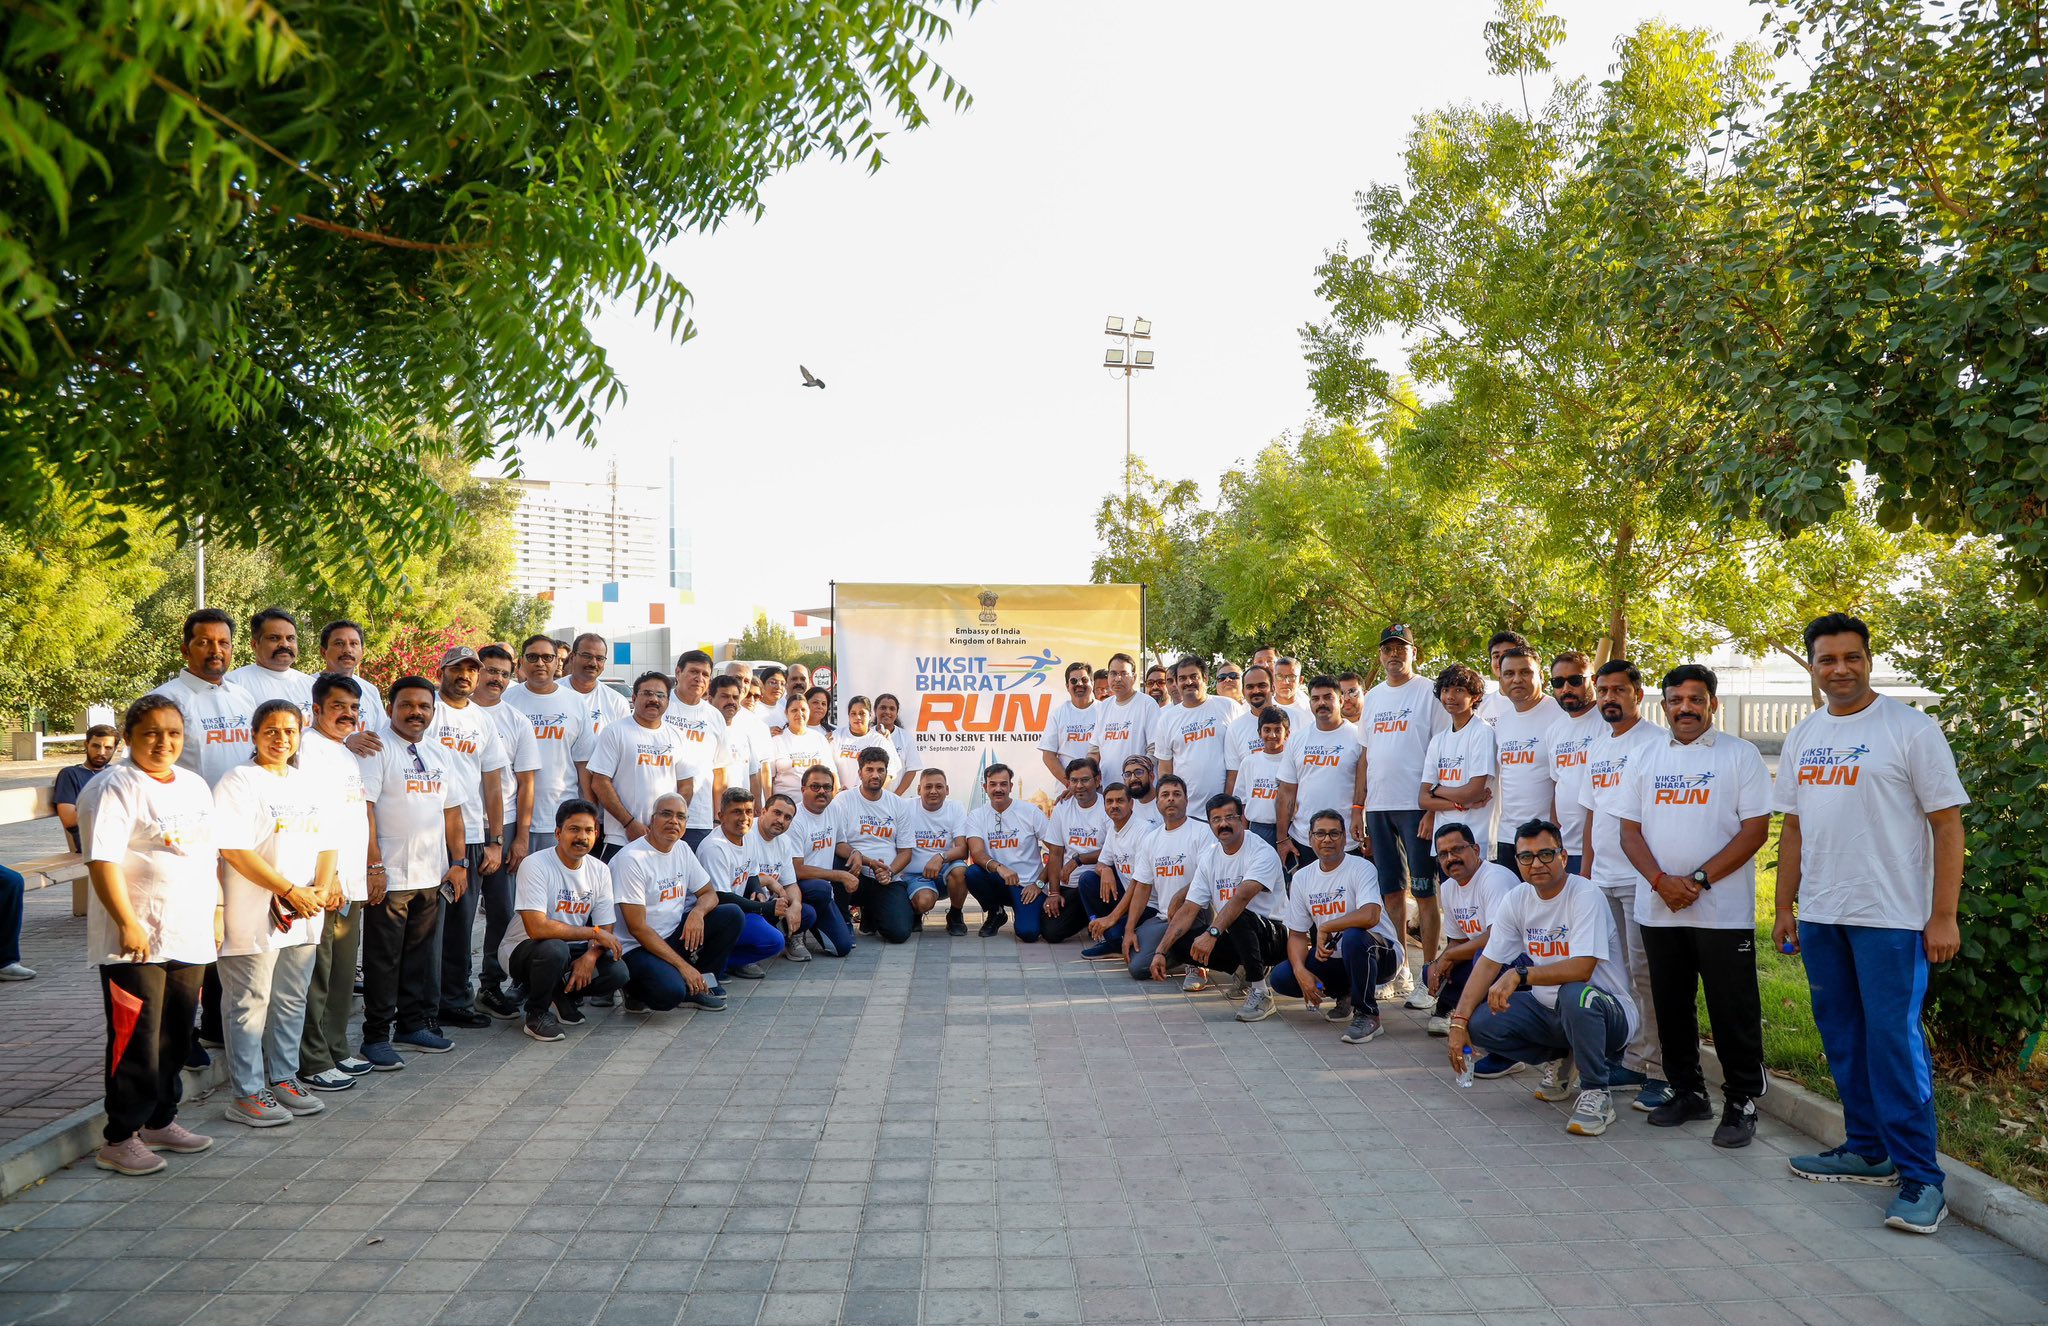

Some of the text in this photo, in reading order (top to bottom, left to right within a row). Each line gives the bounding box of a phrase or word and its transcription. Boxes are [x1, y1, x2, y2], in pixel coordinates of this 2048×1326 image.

[956, 627, 989, 636] Embassy
[1001, 627, 1021, 635] India
[949, 637, 1027, 646] Kingdom of Bahrain
[915, 657, 987, 674] VIKSIT
[916, 674, 1006, 691] BHARAT
[915, 693, 1052, 732] RUN
[201, 716, 226, 725] VIKSIT
[665, 715, 687, 723] VIKSIT
[203, 722, 233, 731] BHARAT
[1181, 722, 1199, 730] VIKSIT
[1181, 725, 1204, 734] BHARAT
[1374, 720, 1408, 734] RUN
[206, 729, 250, 744] RUN
[916, 733, 936, 742] RUN
[939, 733, 951, 742] TO
[955, 733, 985, 742] SERVE
[988, 733, 1007, 742] THE
[1105, 731, 1129, 741] RUN
[1183, 727, 1216, 744] RUN
[1556, 741, 1574, 749] VIKSIT
[1556, 746, 1579, 755] BHARAT
[1501, 751, 1535, 765] RUN
[1802, 747, 1833, 757] VIKSIT
[637, 753, 674, 767] RUN
[1303, 755, 1340, 767] RUN
[1556, 751, 1588, 768] RUN
[1799, 756, 1841, 766] BHARAT
[1591, 766, 1615, 775] BHARAT
[1797, 765, 1860, 786] RUN
[1591, 772, 1621, 789] RUN
[1655, 774, 1684, 782] VIKSIT
[406, 780, 441, 794] RUN
[1655, 781, 1691, 789] BHARAT
[1654, 788, 1710, 805] RUN
[860, 824, 893, 839] RUN
[915, 839, 947, 849] RUN
[989, 838, 1018, 850] RUN
[1069, 836, 1097, 847] RUN
[1155, 865, 1185, 877] RUN
[1310, 897, 1332, 905] BHARAT
[555, 901, 592, 914] RUN
[1311, 901, 1346, 916] RUN
[1457, 920, 1483, 934] RUN
[1527, 934, 1554, 942] BHARAT
[1529, 941, 1569, 957] RUN
